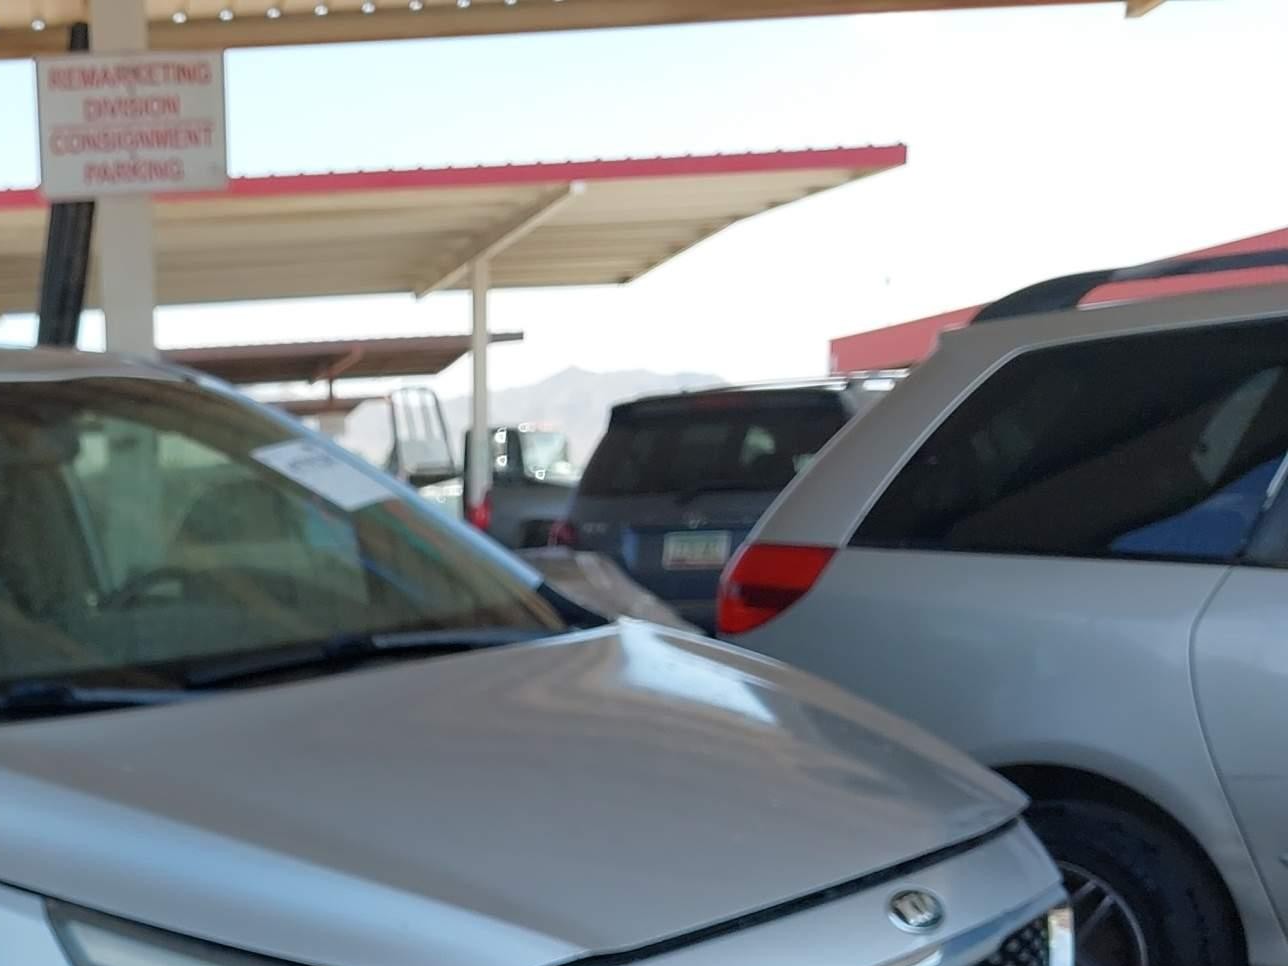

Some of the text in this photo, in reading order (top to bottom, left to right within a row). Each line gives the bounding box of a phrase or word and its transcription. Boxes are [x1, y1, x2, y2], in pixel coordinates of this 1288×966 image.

[49, 62, 210, 89] REMARKETING
[85, 95, 178, 120] DIVISION
[50, 125, 213, 153] CONSIGNMENT
[85, 158, 184, 183] PARKING
